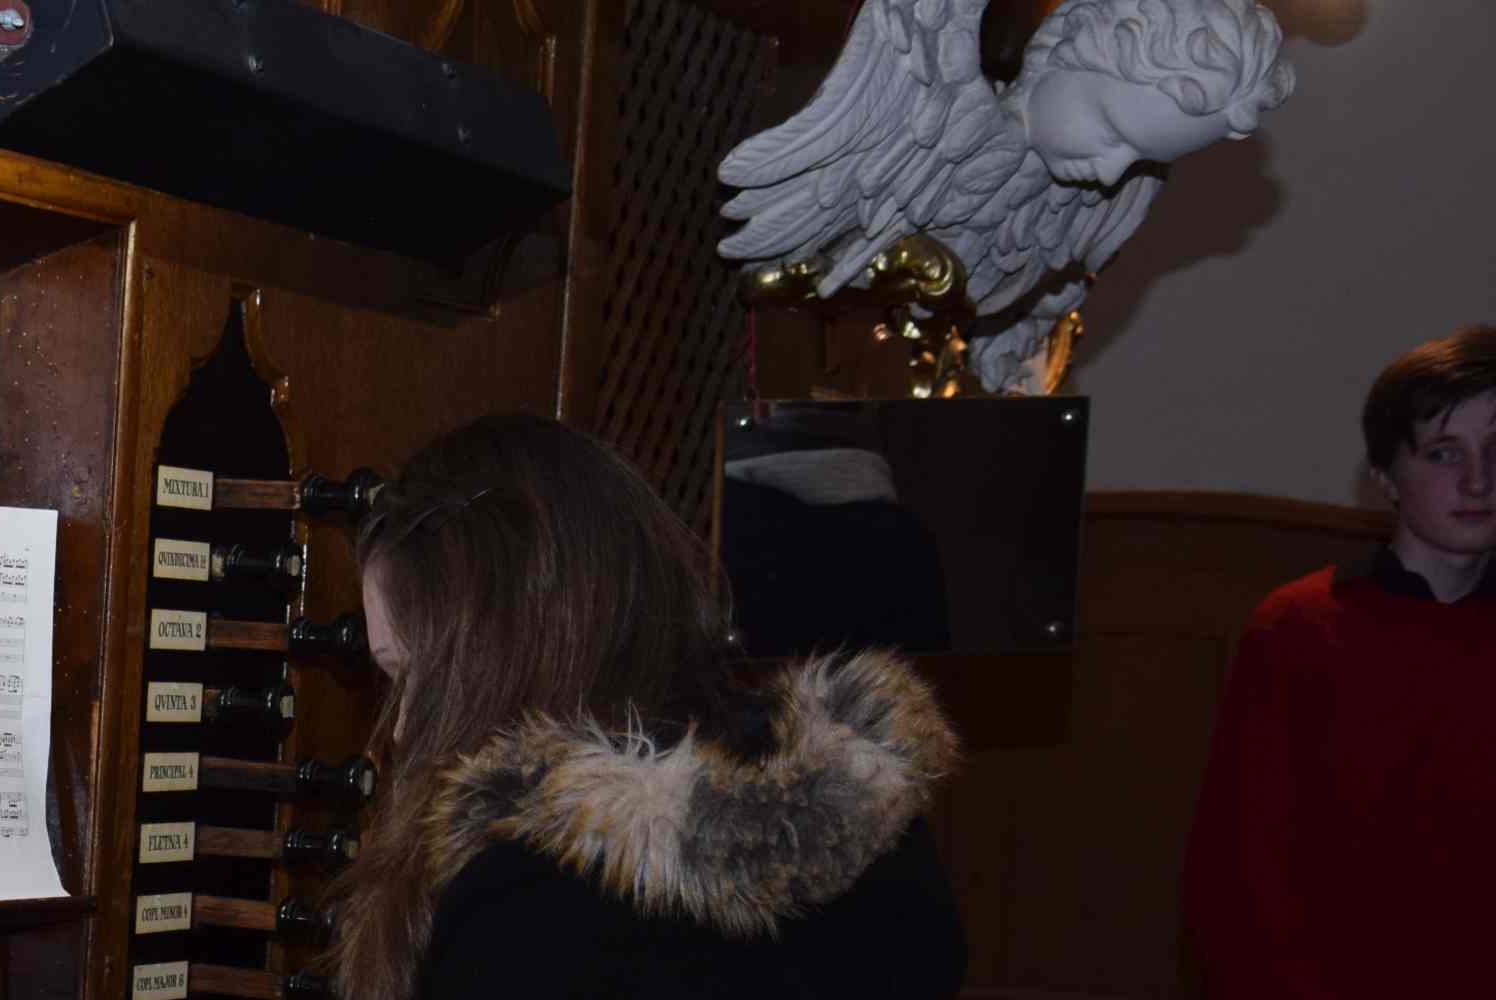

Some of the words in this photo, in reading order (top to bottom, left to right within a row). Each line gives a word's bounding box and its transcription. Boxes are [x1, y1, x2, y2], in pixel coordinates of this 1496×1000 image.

[162, 477, 203, 498] MIXTURA
[158, 621, 193, 639] OCTAVA
[195, 622, 202, 639] 2
